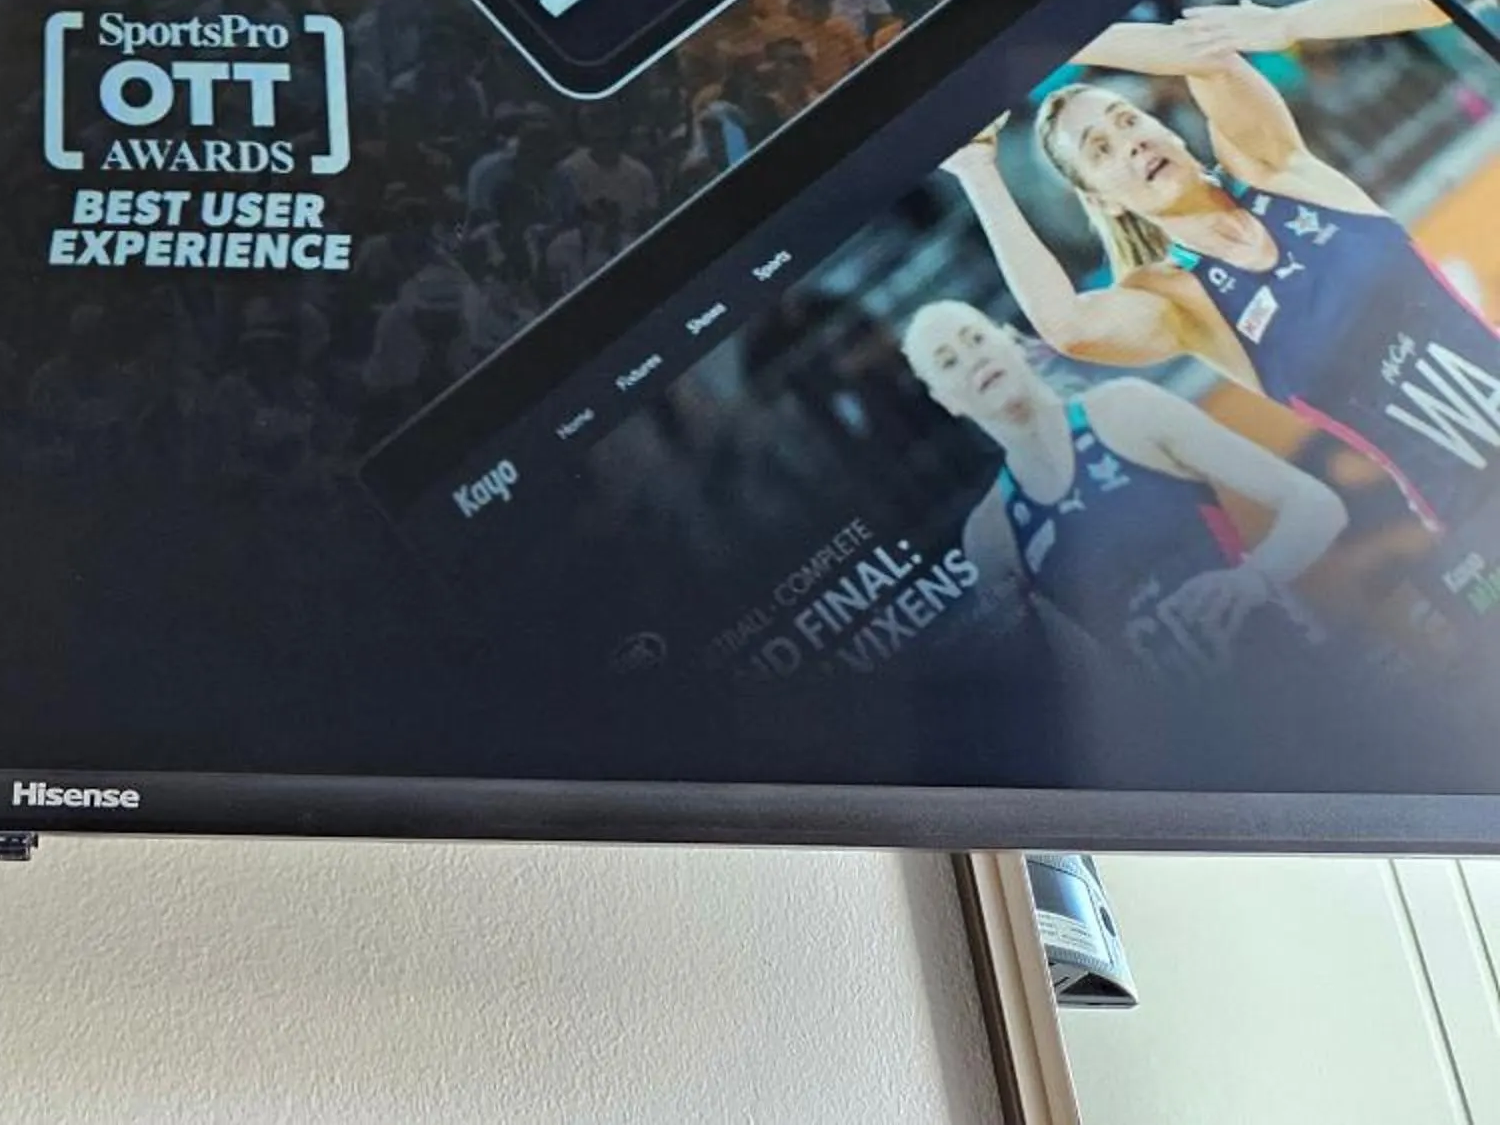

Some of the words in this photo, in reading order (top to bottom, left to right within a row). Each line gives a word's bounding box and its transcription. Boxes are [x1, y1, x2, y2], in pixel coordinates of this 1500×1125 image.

[99, 12, 290, 54] SportsPro
[99, 59, 292, 127] OTT
[101, 139, 296, 174] AWARDS
[72, 189, 192, 226] BEST
[200, 191, 326, 228] USER
[48, 229, 353, 271] EXPERIENCE
[452, 458, 520, 518] Kayo
[773, 517, 874, 608] COMPLETE
[793, 539, 924, 652] FINAL:
[835, 548, 981, 673] VIXENS
[12, 780, 141, 809] Hisense
